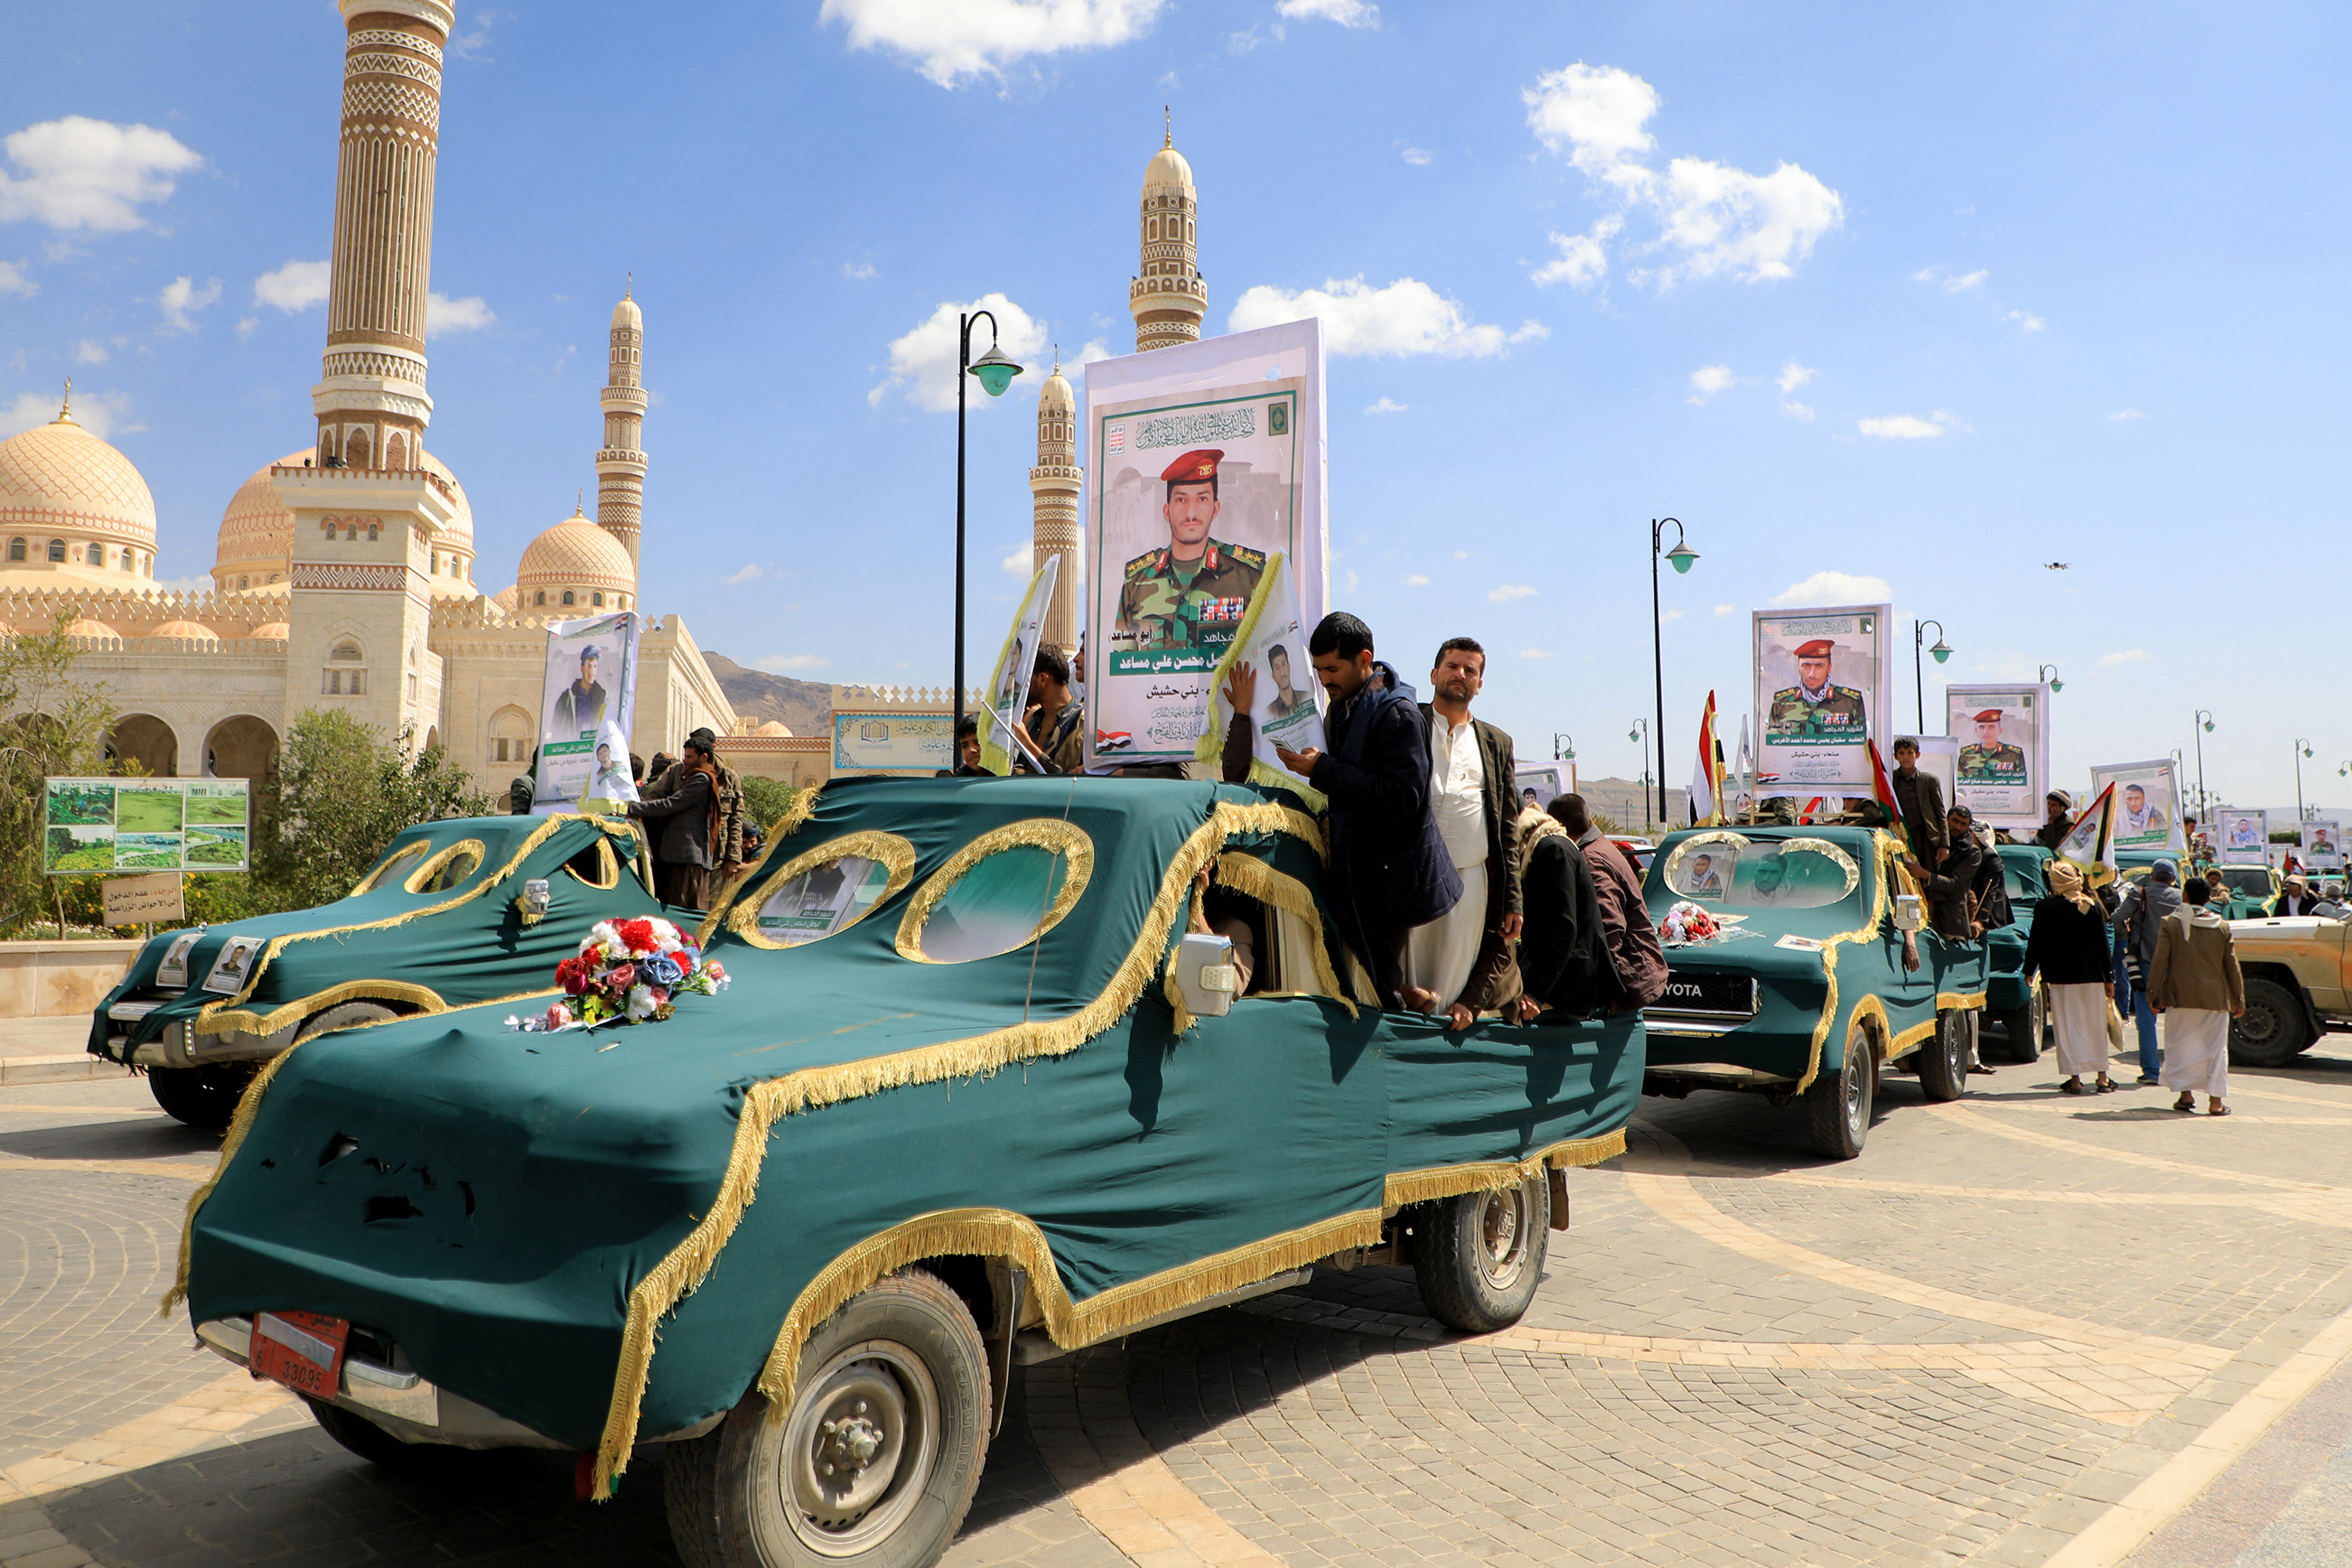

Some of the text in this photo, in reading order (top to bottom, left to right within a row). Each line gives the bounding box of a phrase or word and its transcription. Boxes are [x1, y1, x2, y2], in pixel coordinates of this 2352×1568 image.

[1120, 656, 1150, 669] مساعد
[1153, 655, 1172, 674] علي
[1174, 656, 1205, 670] محسن
[1146, 685, 1180, 699] حشيش
[1181, 685, 1199, 700] بني
[1823, 725, 1863, 734] الشهيد المجاهد
[108, 891, 134, 902] الدخول
[135, 891, 149, 900] عدم
[1665, 984, 1703, 997] YOTA
[256, 1350, 322, 1390] 6 33095
